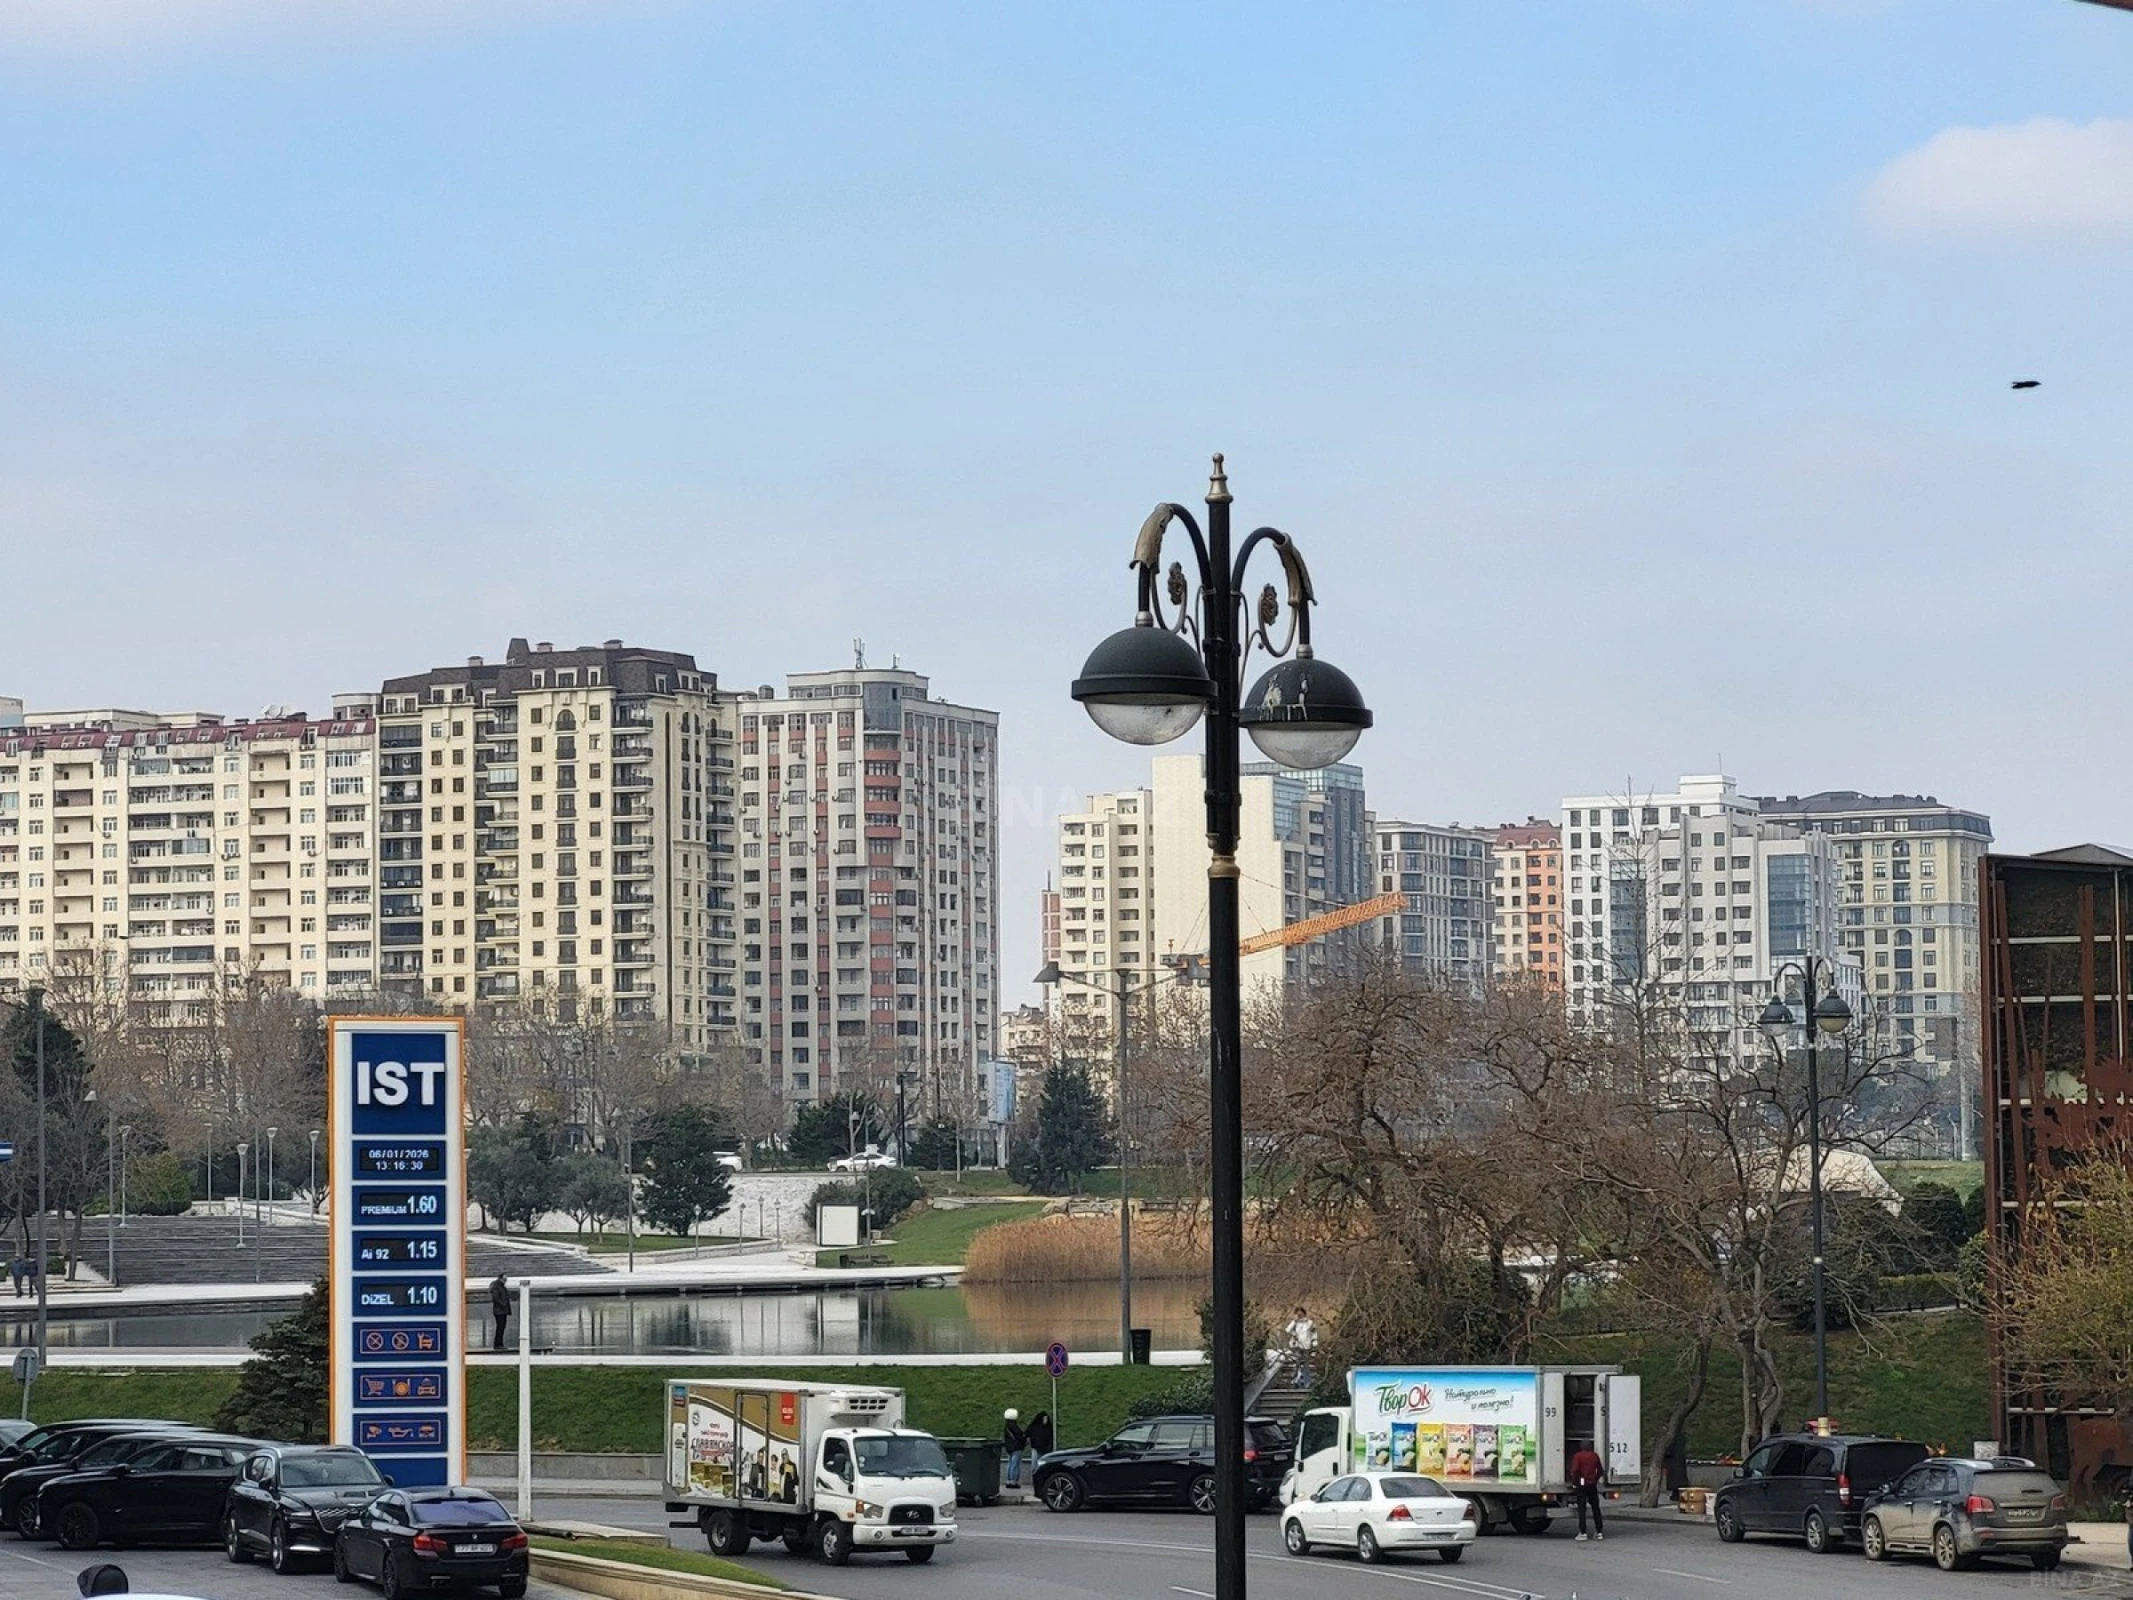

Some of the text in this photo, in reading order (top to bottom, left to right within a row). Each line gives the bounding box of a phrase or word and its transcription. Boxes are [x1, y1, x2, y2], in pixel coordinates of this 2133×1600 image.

[357, 1061, 445, 1106] IST
[361, 1195, 438, 1215] PREMIUM 1.60
[375, 1248, 390, 1260] 92
[407, 1241, 438, 1259] 1.15
[407, 1286, 438, 1304] 1.10
[1545, 1407, 1557, 1418] 99
